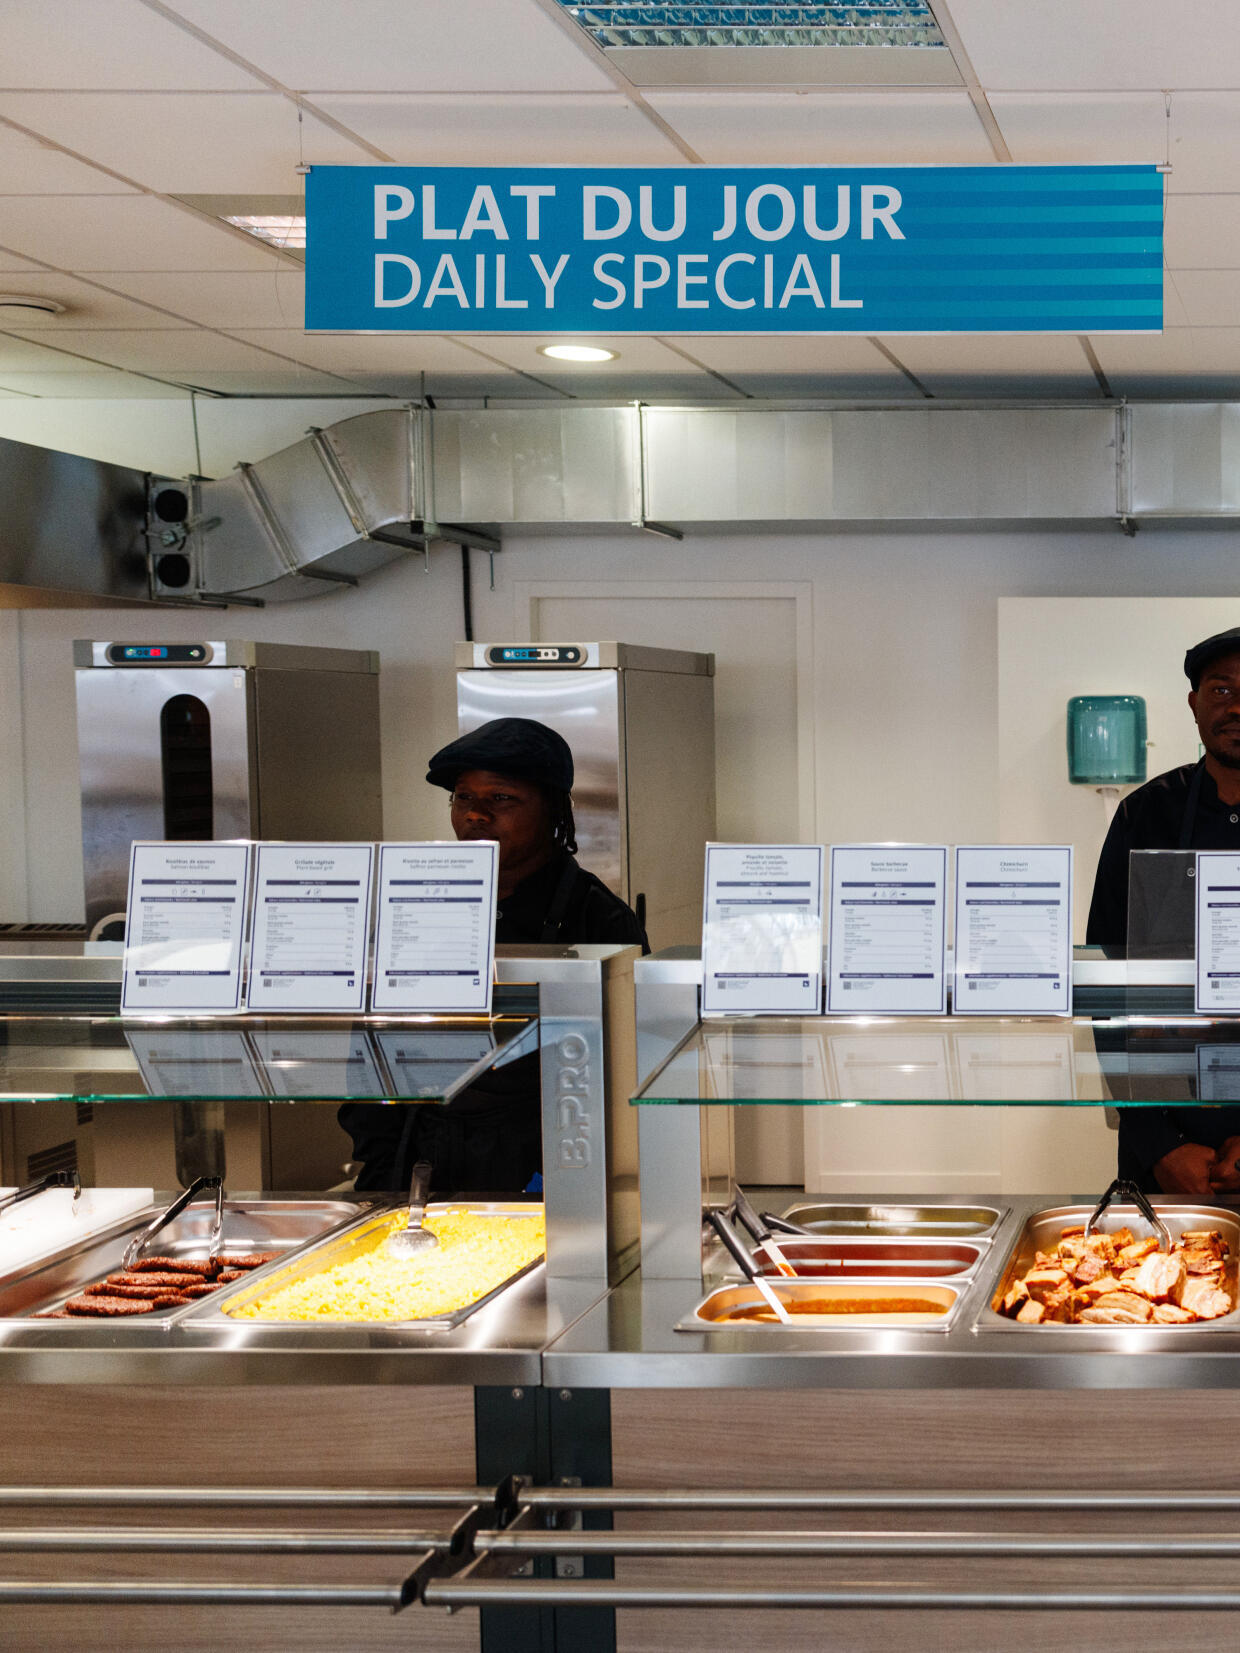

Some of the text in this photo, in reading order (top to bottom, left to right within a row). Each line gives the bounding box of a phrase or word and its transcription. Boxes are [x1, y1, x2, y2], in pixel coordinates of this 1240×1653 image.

[373, 183, 906, 242] PLAT DU JOUR
[373, 252, 864, 310] DAILY SPECIAL
[559, 1032, 591, 1169] B.PRO
